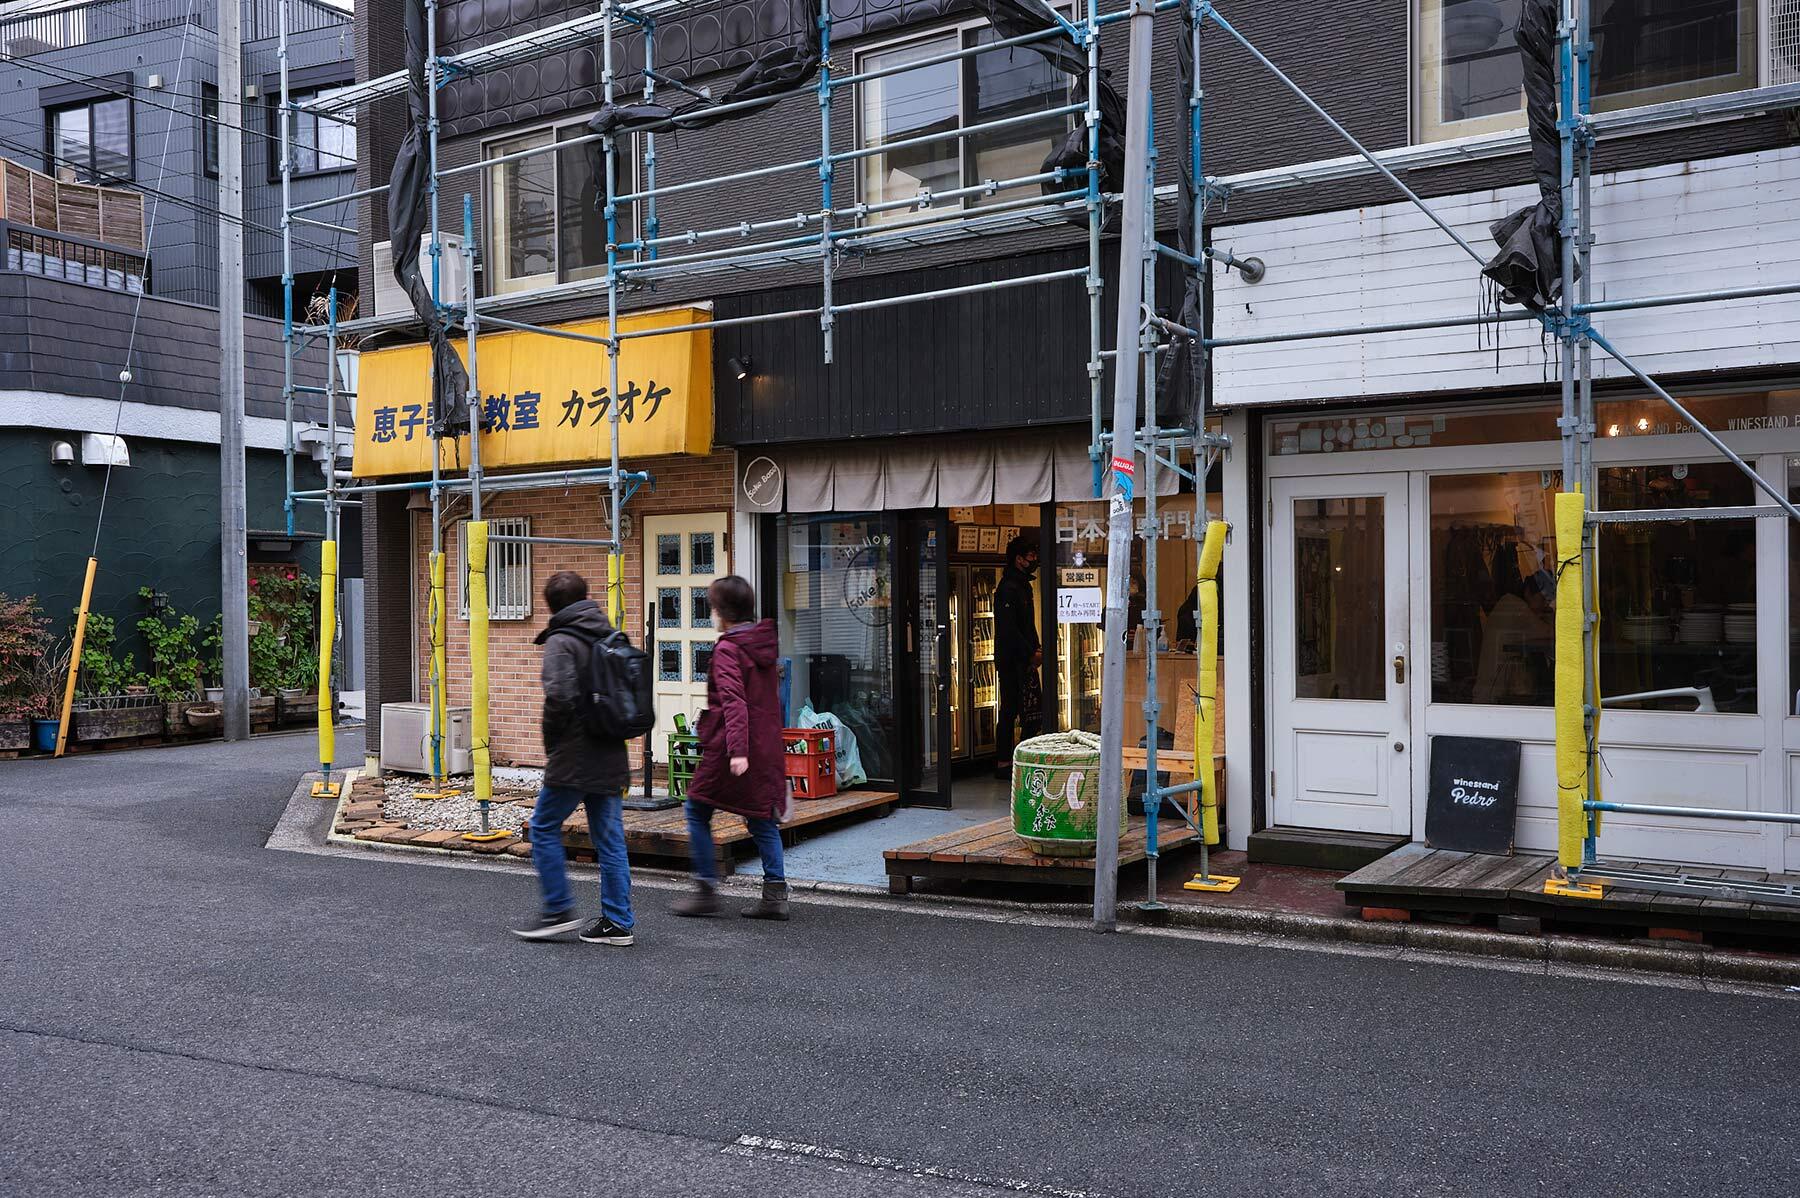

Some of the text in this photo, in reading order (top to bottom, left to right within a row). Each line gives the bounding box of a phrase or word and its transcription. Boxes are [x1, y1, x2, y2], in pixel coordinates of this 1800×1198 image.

[371, 380, 671, 443] 恵子教室 カラオケ
[1066, 572, 1094, 583] 営業中
[1453, 778, 1499, 791] winestand
[1451, 787, 1497, 806] Pedro
